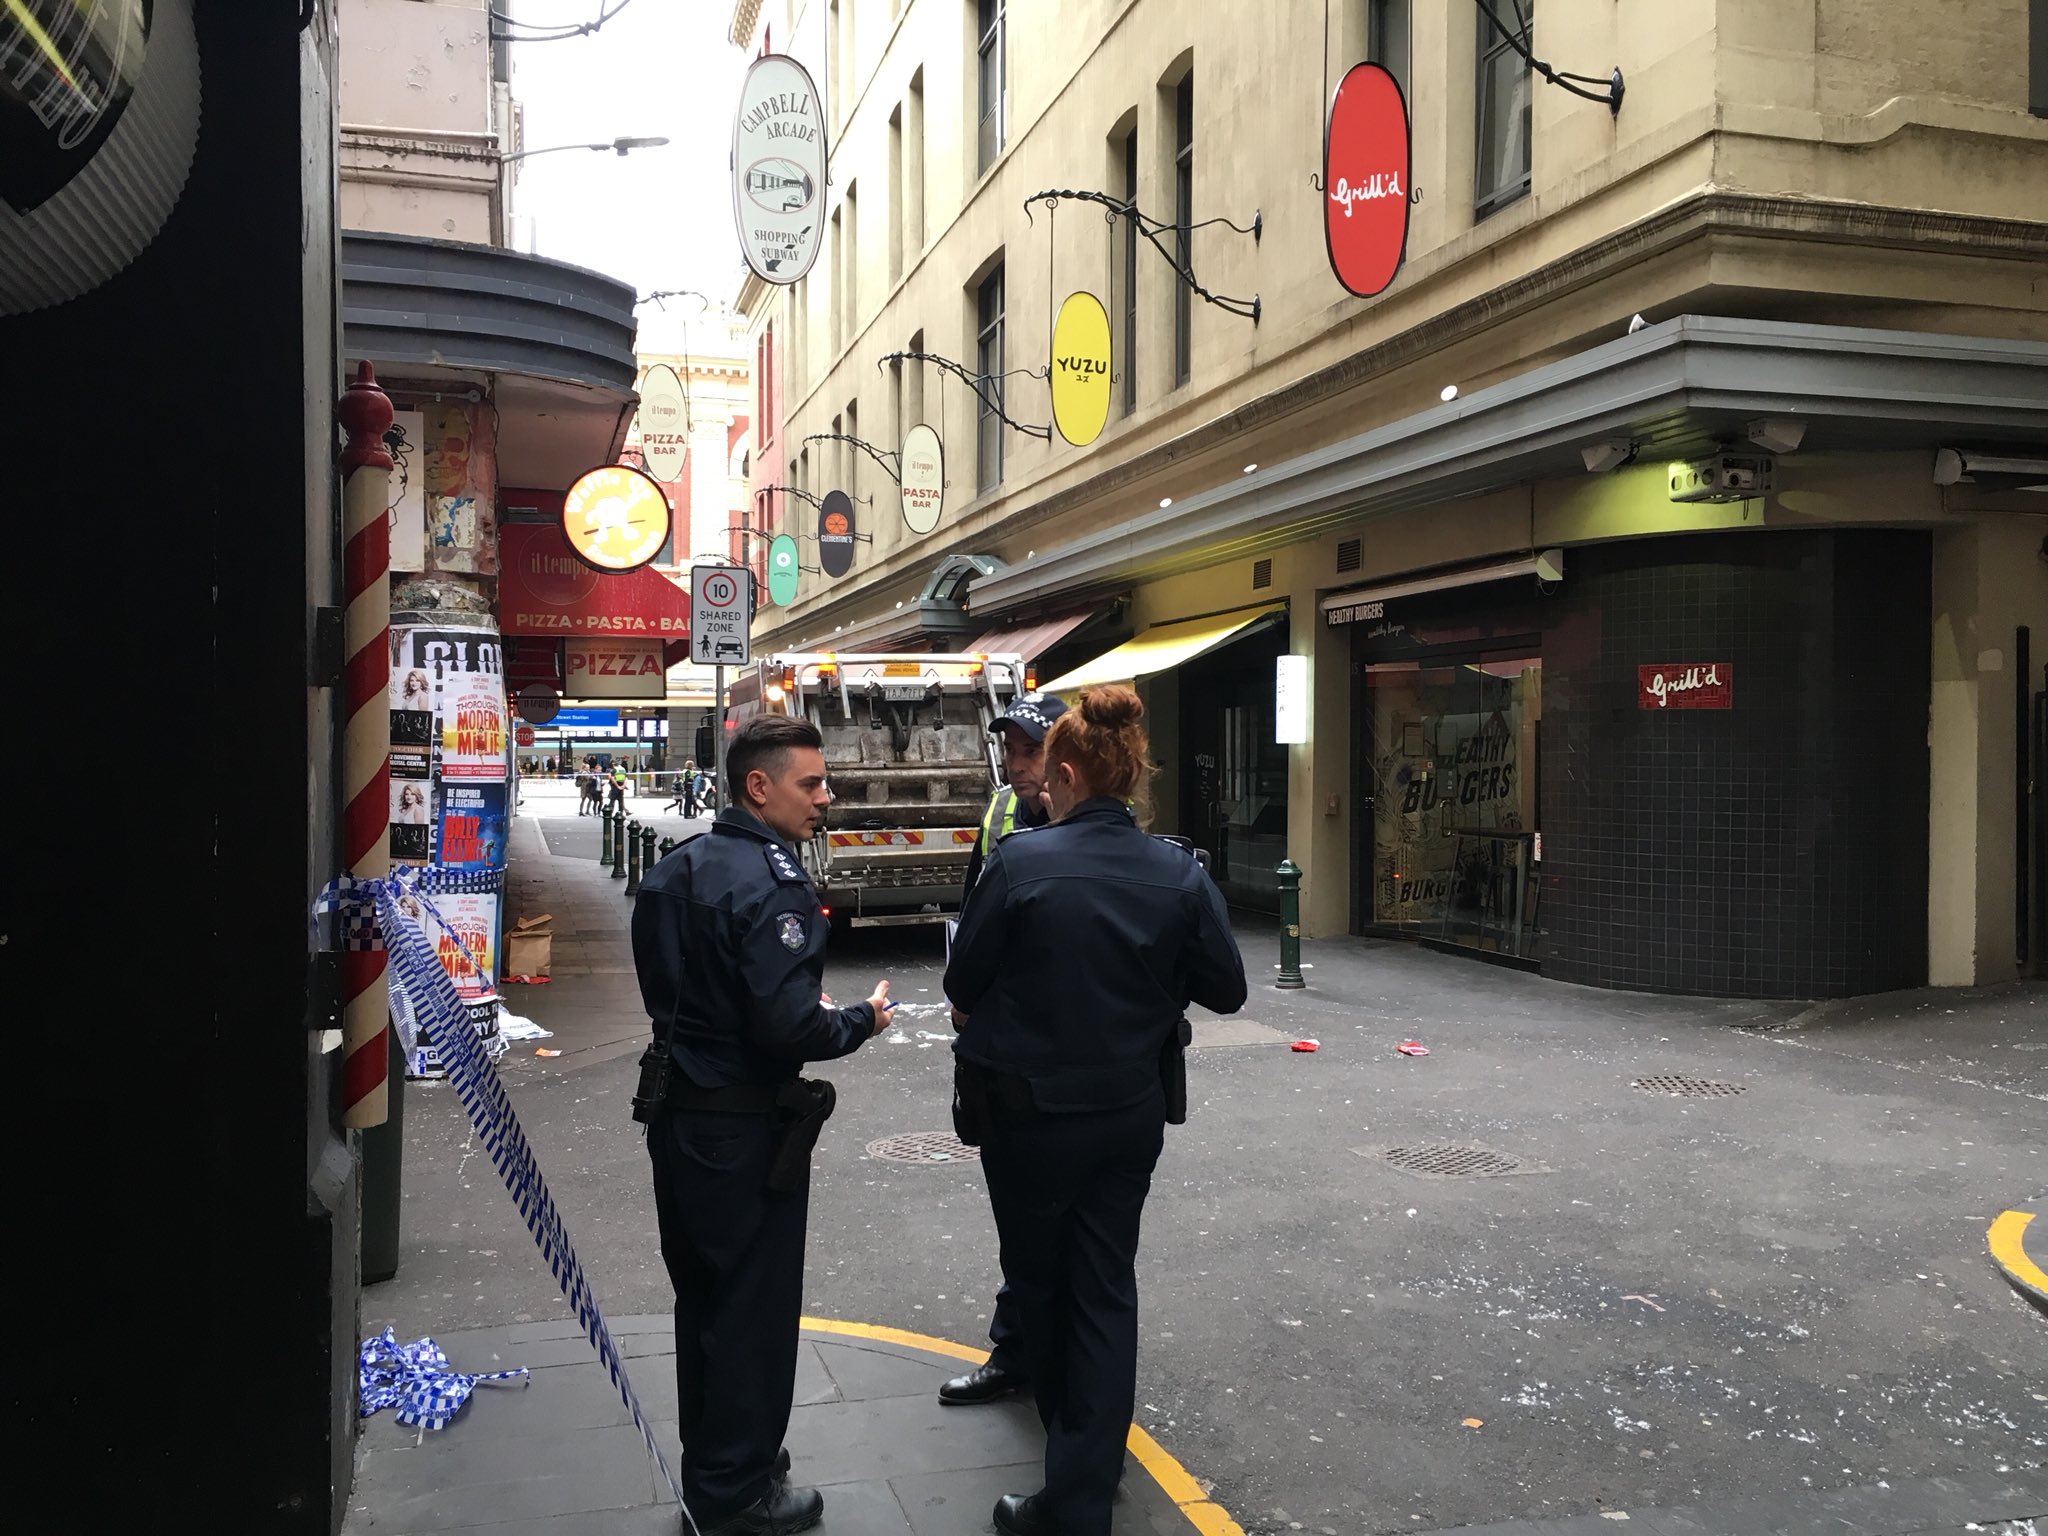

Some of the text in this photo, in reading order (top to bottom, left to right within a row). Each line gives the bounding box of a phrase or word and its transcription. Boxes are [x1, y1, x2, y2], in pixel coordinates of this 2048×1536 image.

[741, 93, 808, 134] CAMPBELL
[767, 121, 816, 143] ARCADE
[1331, 171, 1403, 217] Grill'd
[755, 229, 805, 244] SHOPPING
[761, 248, 799, 261] SUBWAY
[1057, 357, 1106, 374] YUZU
[644, 434, 685, 444] PIZZA
[654, 446, 676, 454] BAR
[904, 488, 940, 499] PASTA
[714, 584, 728, 598] 10
[700, 610, 742, 620] SHARED
[1355, 602, 1384, 621] BURGERS
[516, 614, 690, 630] PIZZA PASTA BA
[706, 623, 734, 632] ZONE
[566, 654, 662, 676] PIZZA
[1646, 664, 1722, 706] Grill'd
[456, 710, 500, 732] MODERN
[516, 732, 534, 742] STOP
[1441, 735, 1510, 769] EALTHY
[1195, 754, 1215, 768] YUZU
[447, 788, 480, 798] BE INSPIRED
[1402, 763, 1512, 813] BUGERS
[446, 798, 484, 808] BE ELECTRIFIED
[444, 816, 480, 839] BILLY
[440, 922, 488, 934] TOROUGHLY
[439, 932, 488, 954] MODERN
